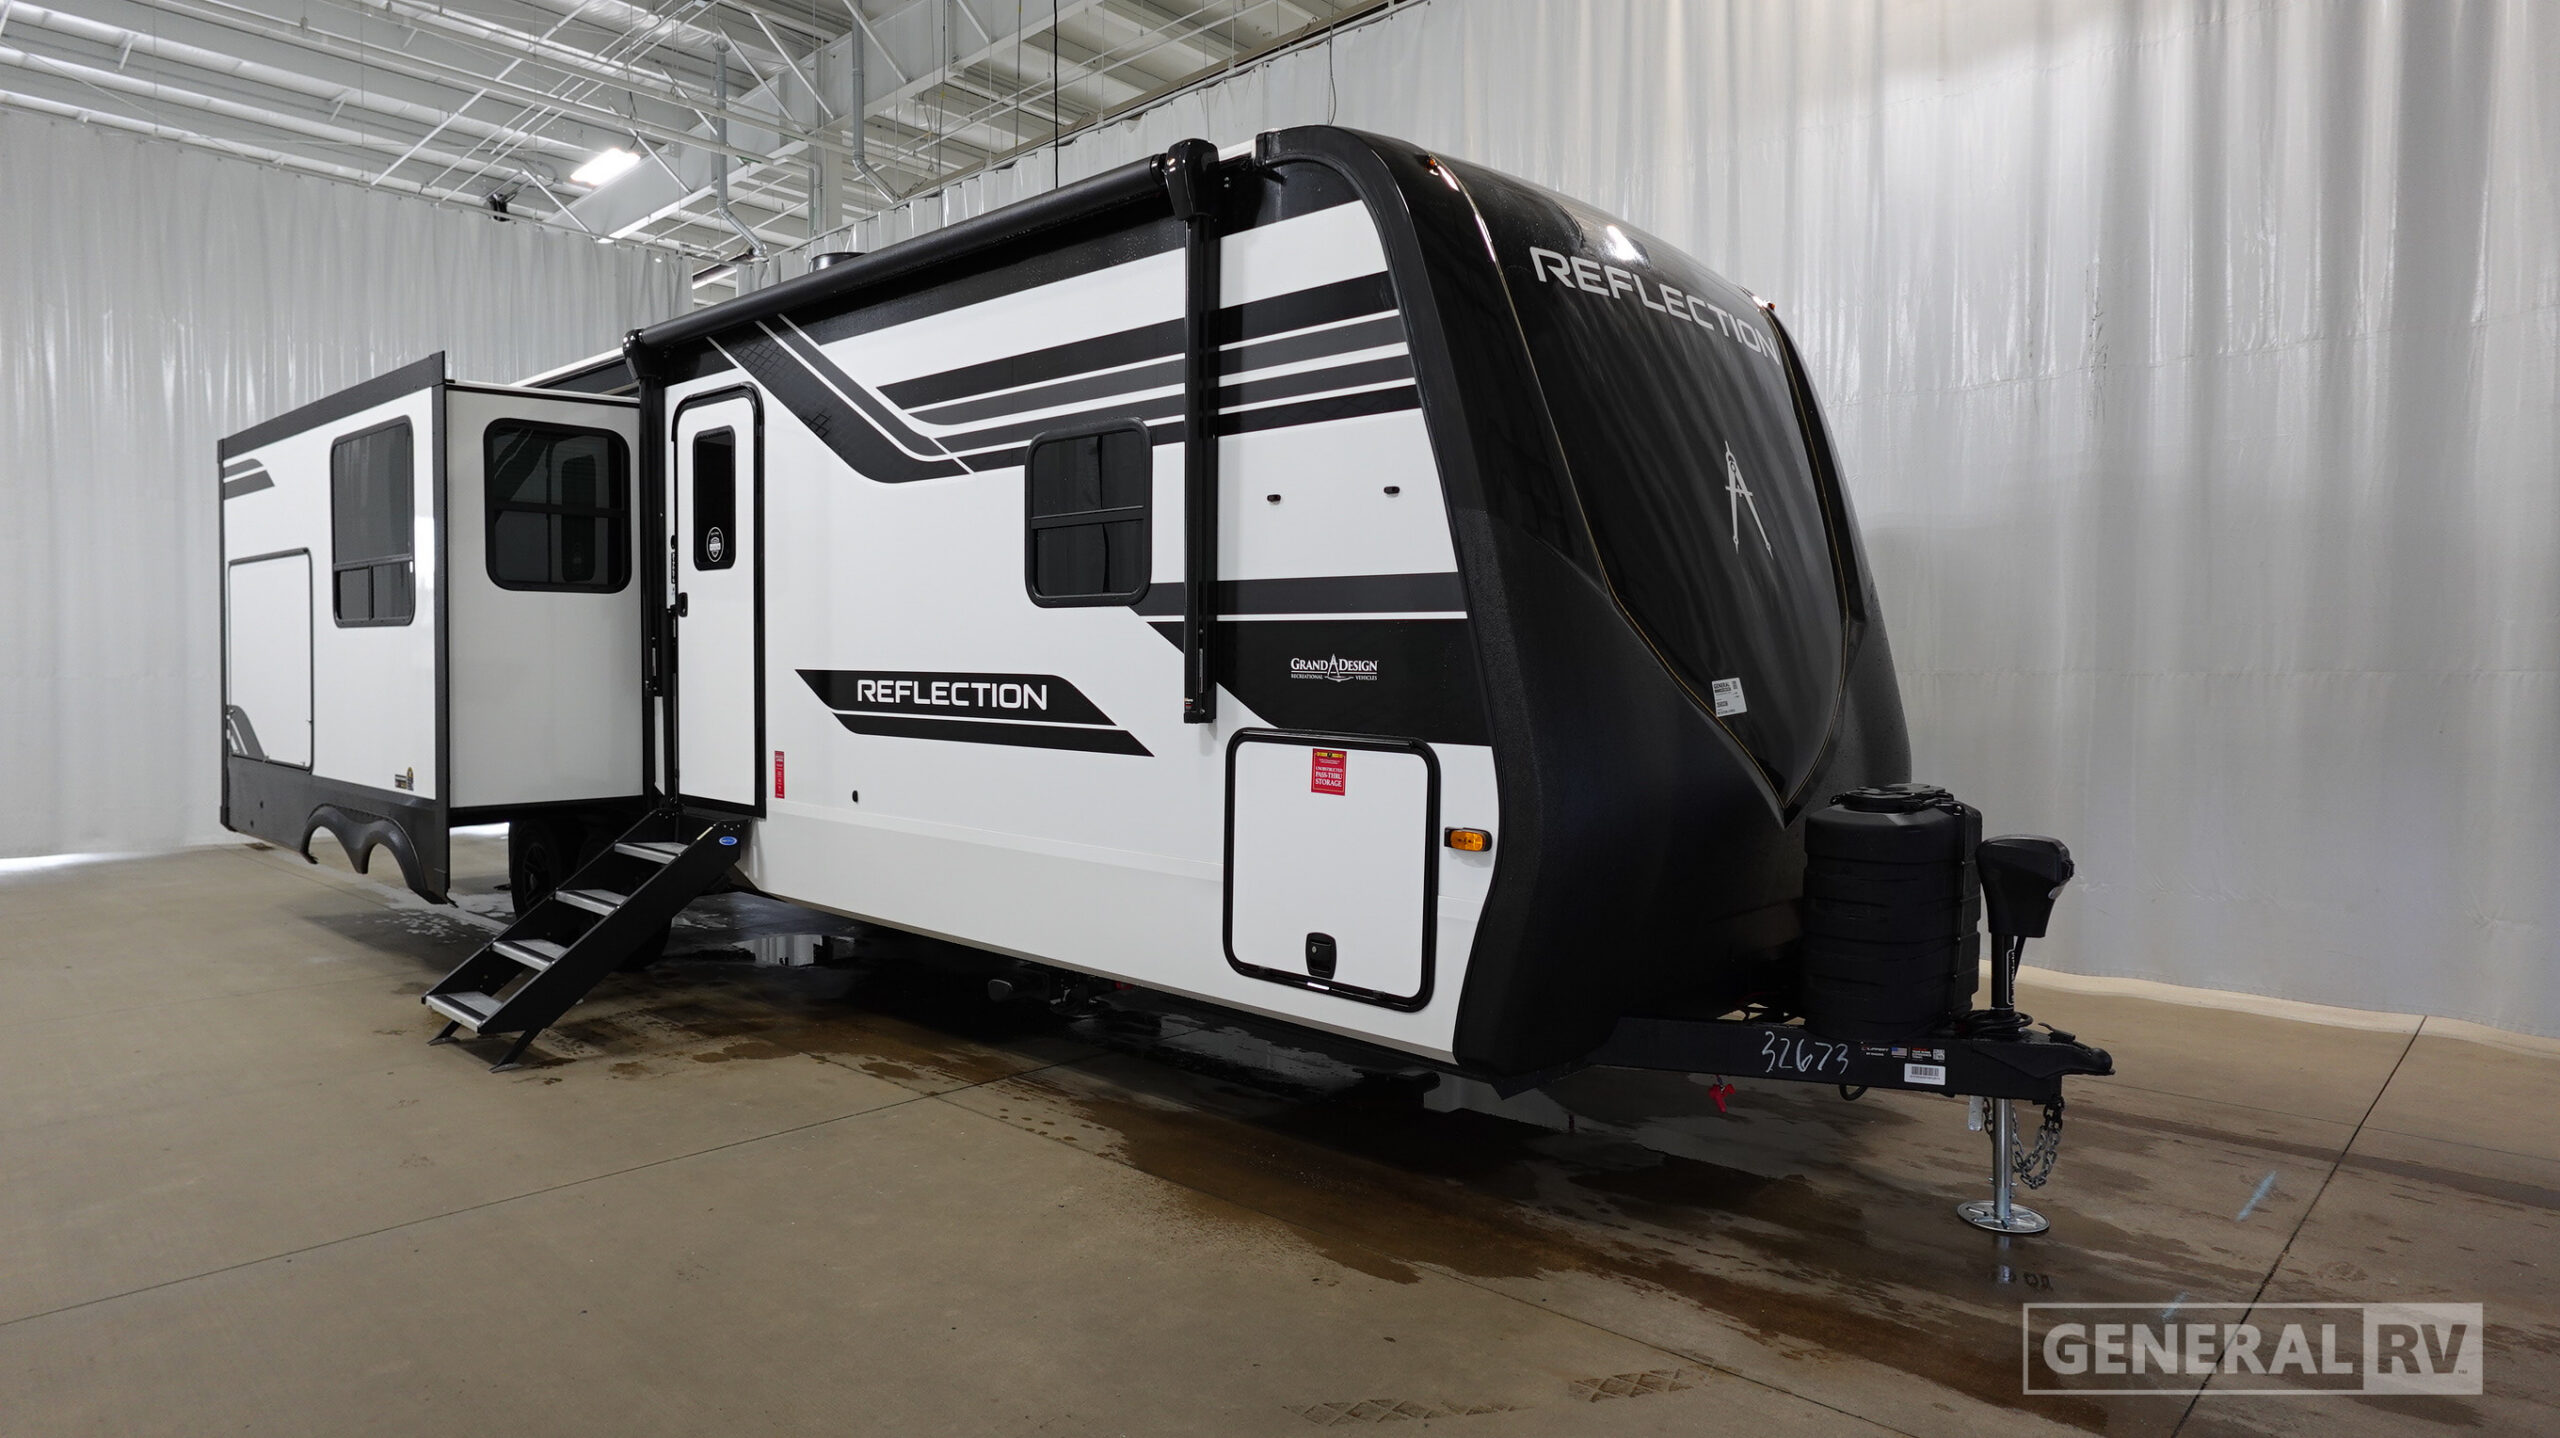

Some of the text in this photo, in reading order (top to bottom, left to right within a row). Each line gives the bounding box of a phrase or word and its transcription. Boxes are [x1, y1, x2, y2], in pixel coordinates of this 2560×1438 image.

[1529, 246, 1780, 366] REFLECTION
[1290, 657, 1378, 671] GRAND DESIGN
[856, 679, 1048, 710] REFLECTION
[1315, 778, 1342, 787] STORAGE
[1761, 1031, 1849, 1074] 32673
